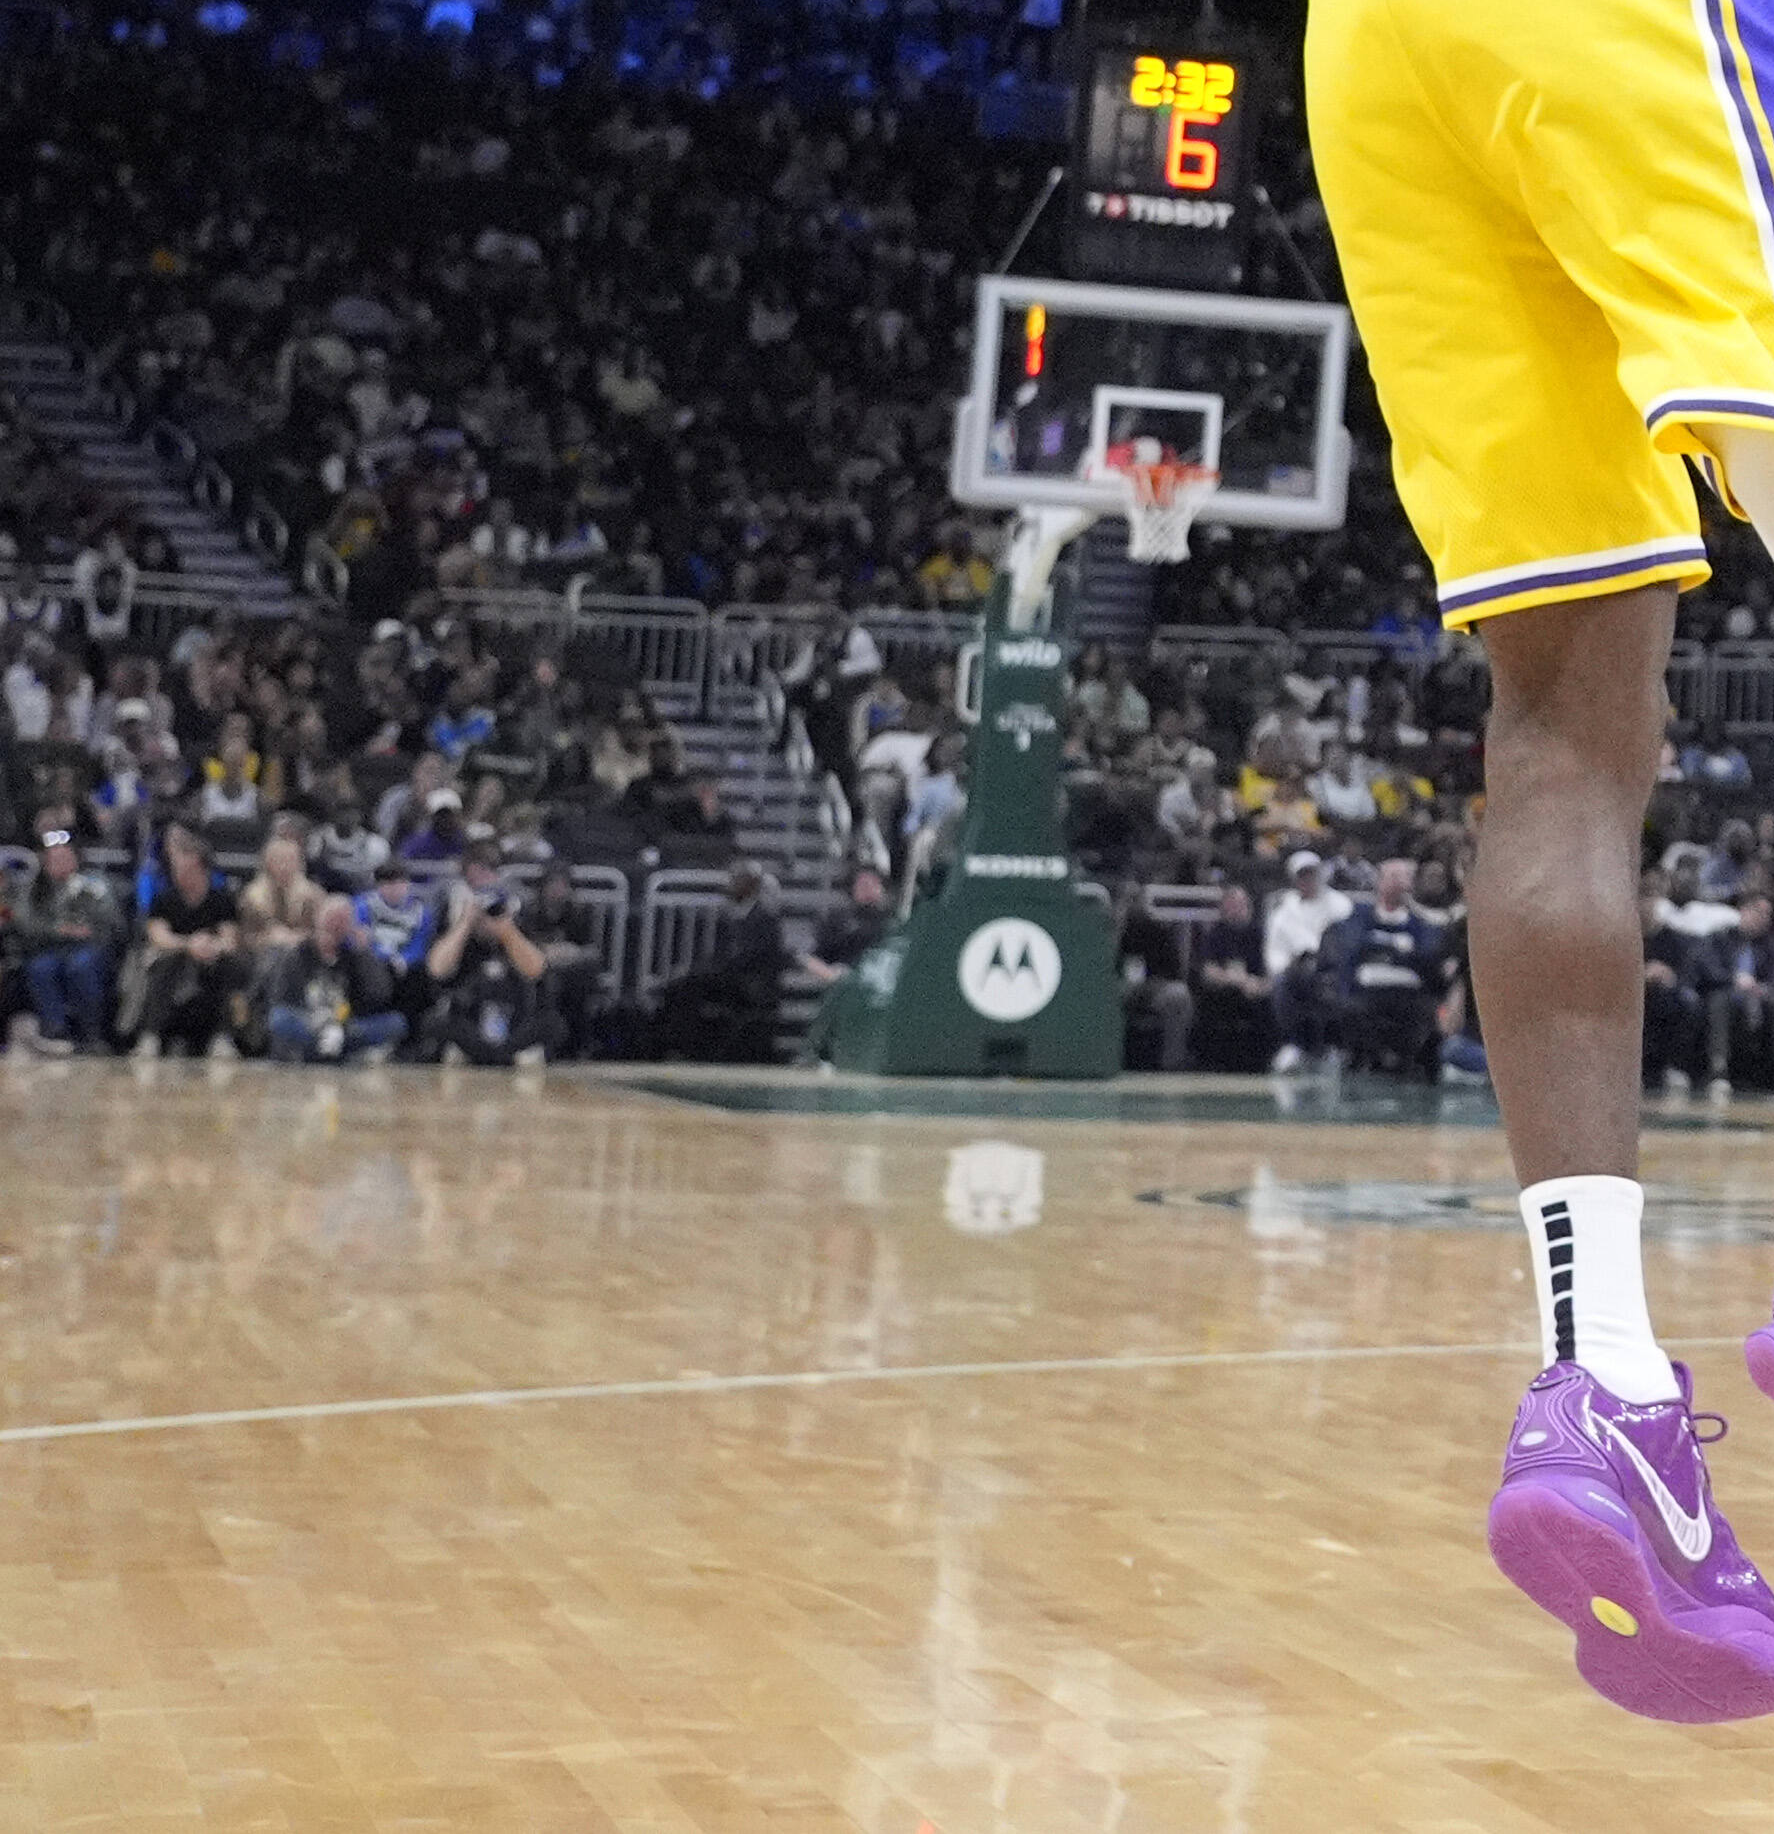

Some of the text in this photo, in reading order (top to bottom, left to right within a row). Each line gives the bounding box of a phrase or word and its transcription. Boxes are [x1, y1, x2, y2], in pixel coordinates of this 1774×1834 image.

[1131, 56, 1235, 114] 2:32
[1165, 110, 1222, 190] 6
[1127, 195, 1236, 230] TISSOT
